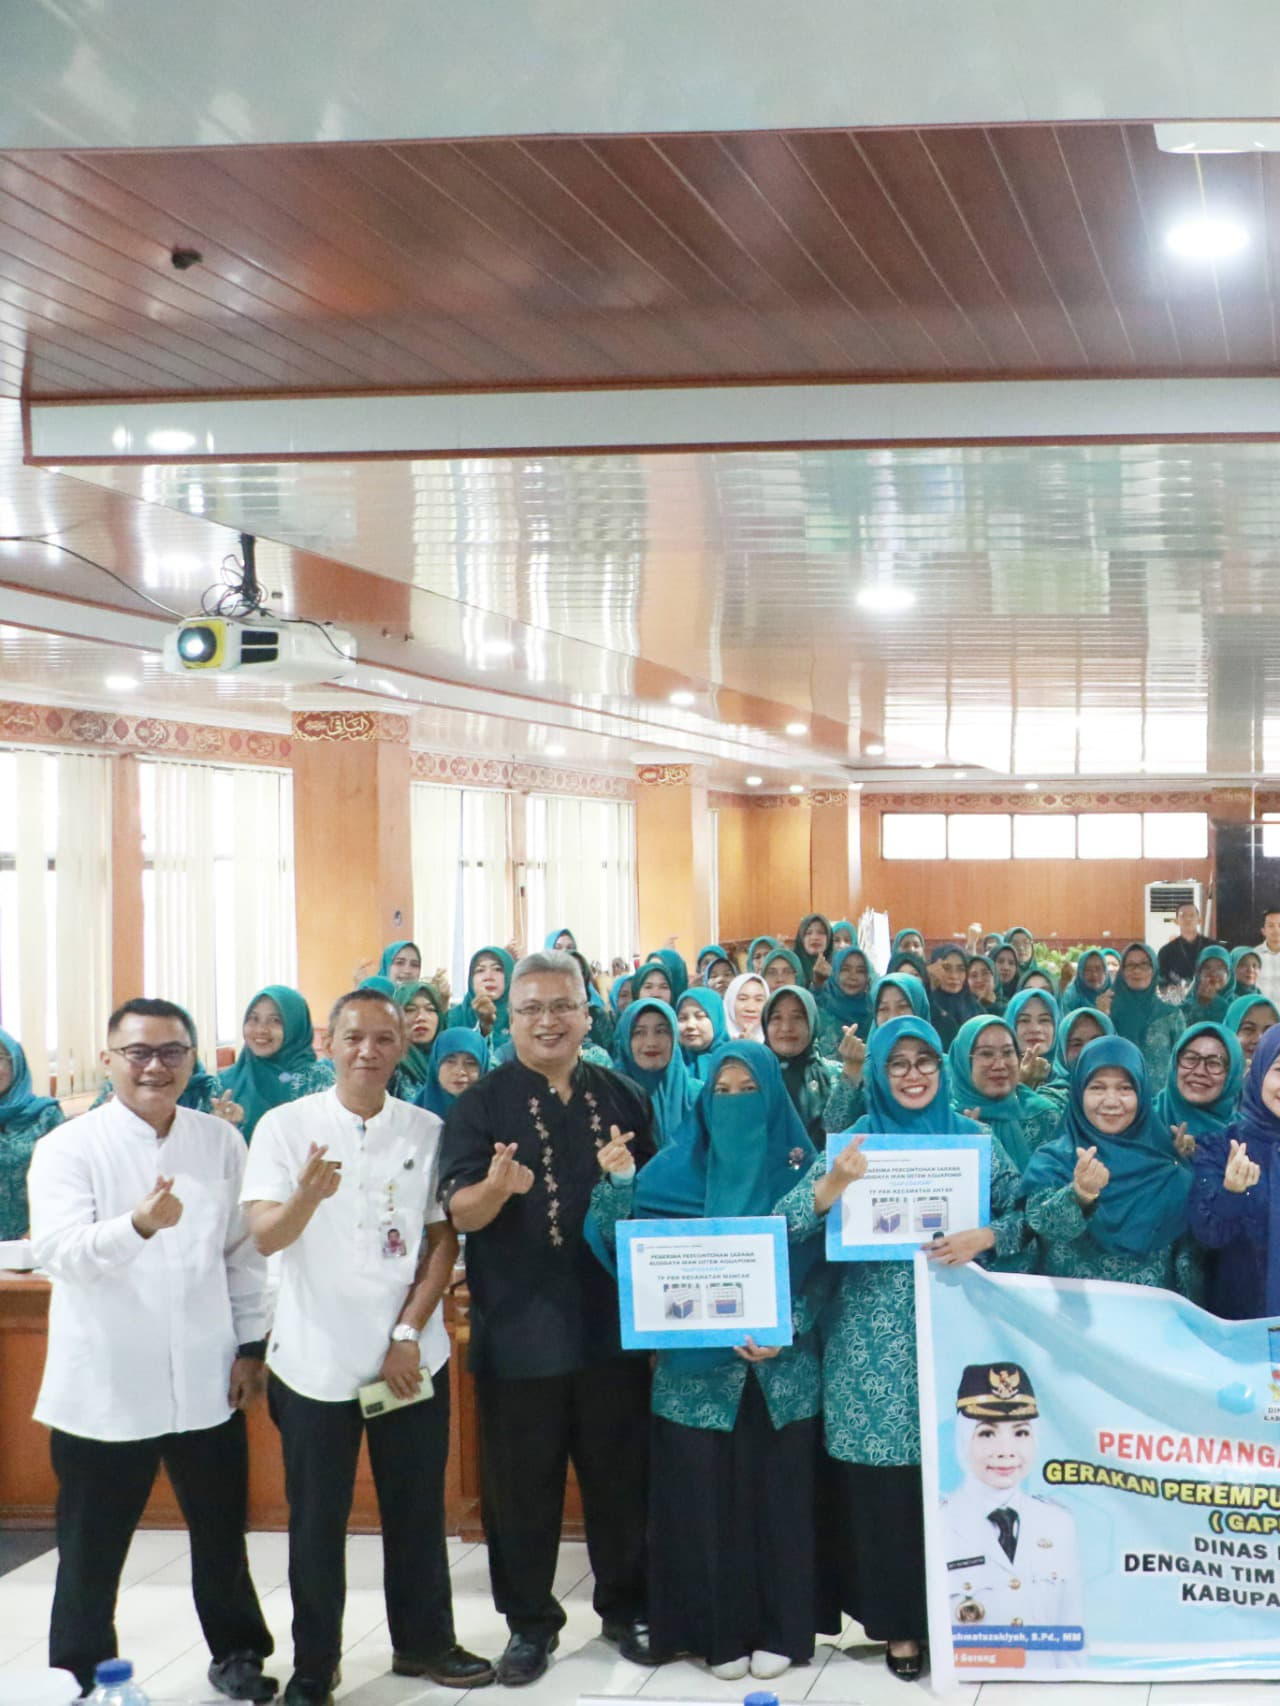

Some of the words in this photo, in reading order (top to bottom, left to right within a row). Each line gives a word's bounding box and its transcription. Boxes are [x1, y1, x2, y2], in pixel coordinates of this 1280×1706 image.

[1044, 1460, 1159, 1497] GERAKAN
[1194, 1537, 1268, 1560] DINAS
[1124, 1553, 1223, 1578] DENGAN
[1231, 1565, 1275, 1584] TIM
